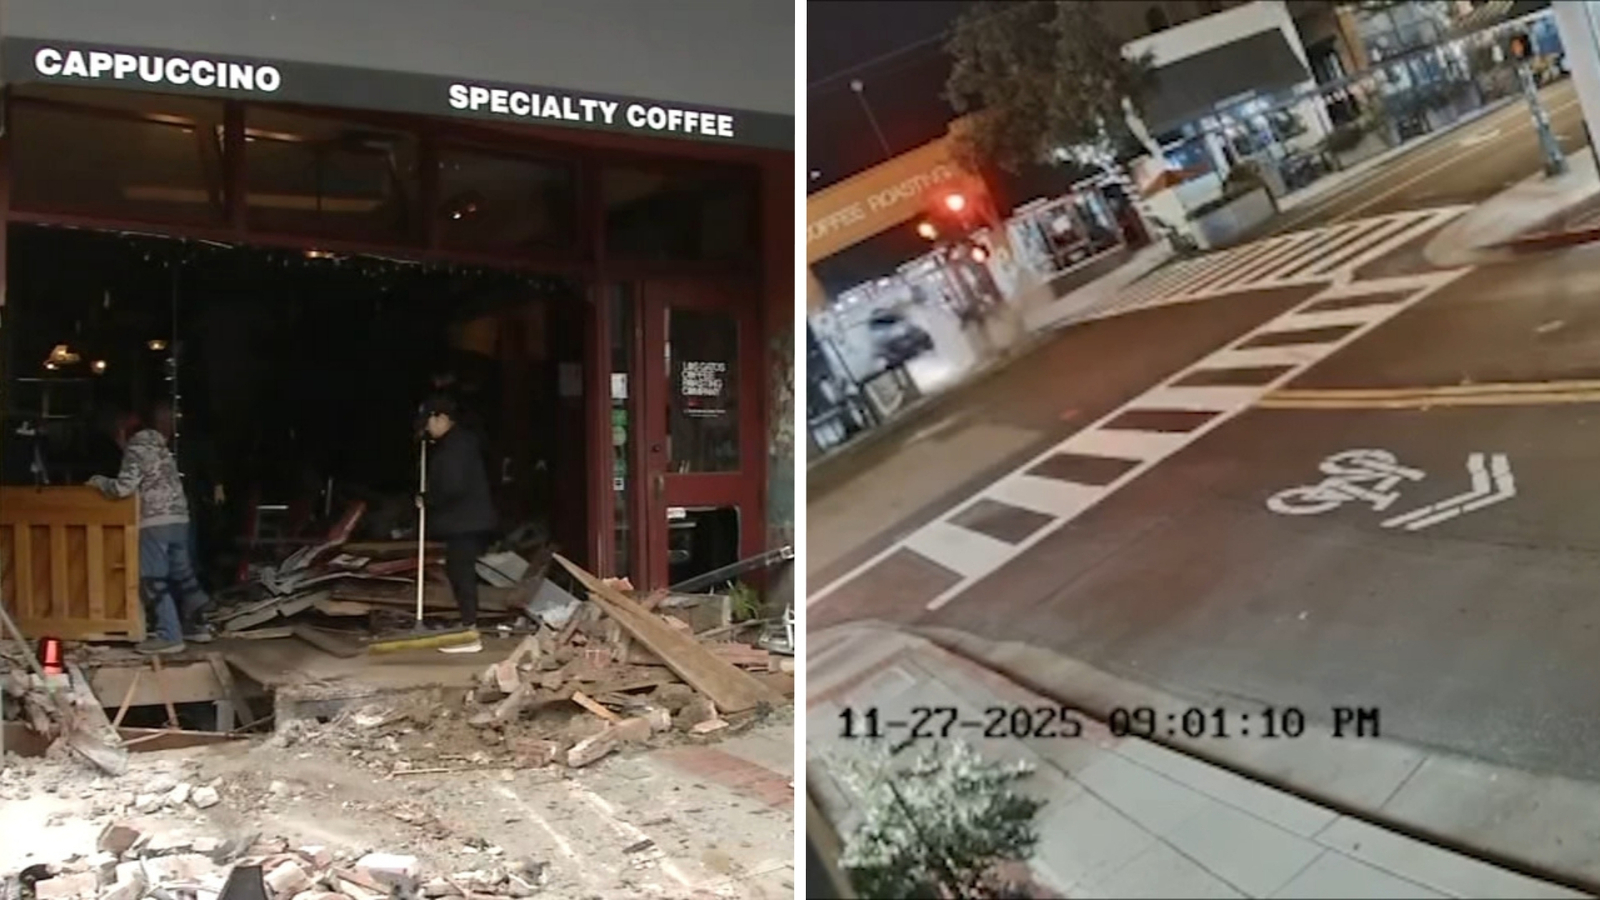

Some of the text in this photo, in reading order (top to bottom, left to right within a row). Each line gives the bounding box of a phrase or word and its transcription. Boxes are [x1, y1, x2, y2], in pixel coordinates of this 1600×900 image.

[34, 47, 282, 93] CAPPUCCINO
[448, 83, 735, 138] SPECIALTY COFFEE
